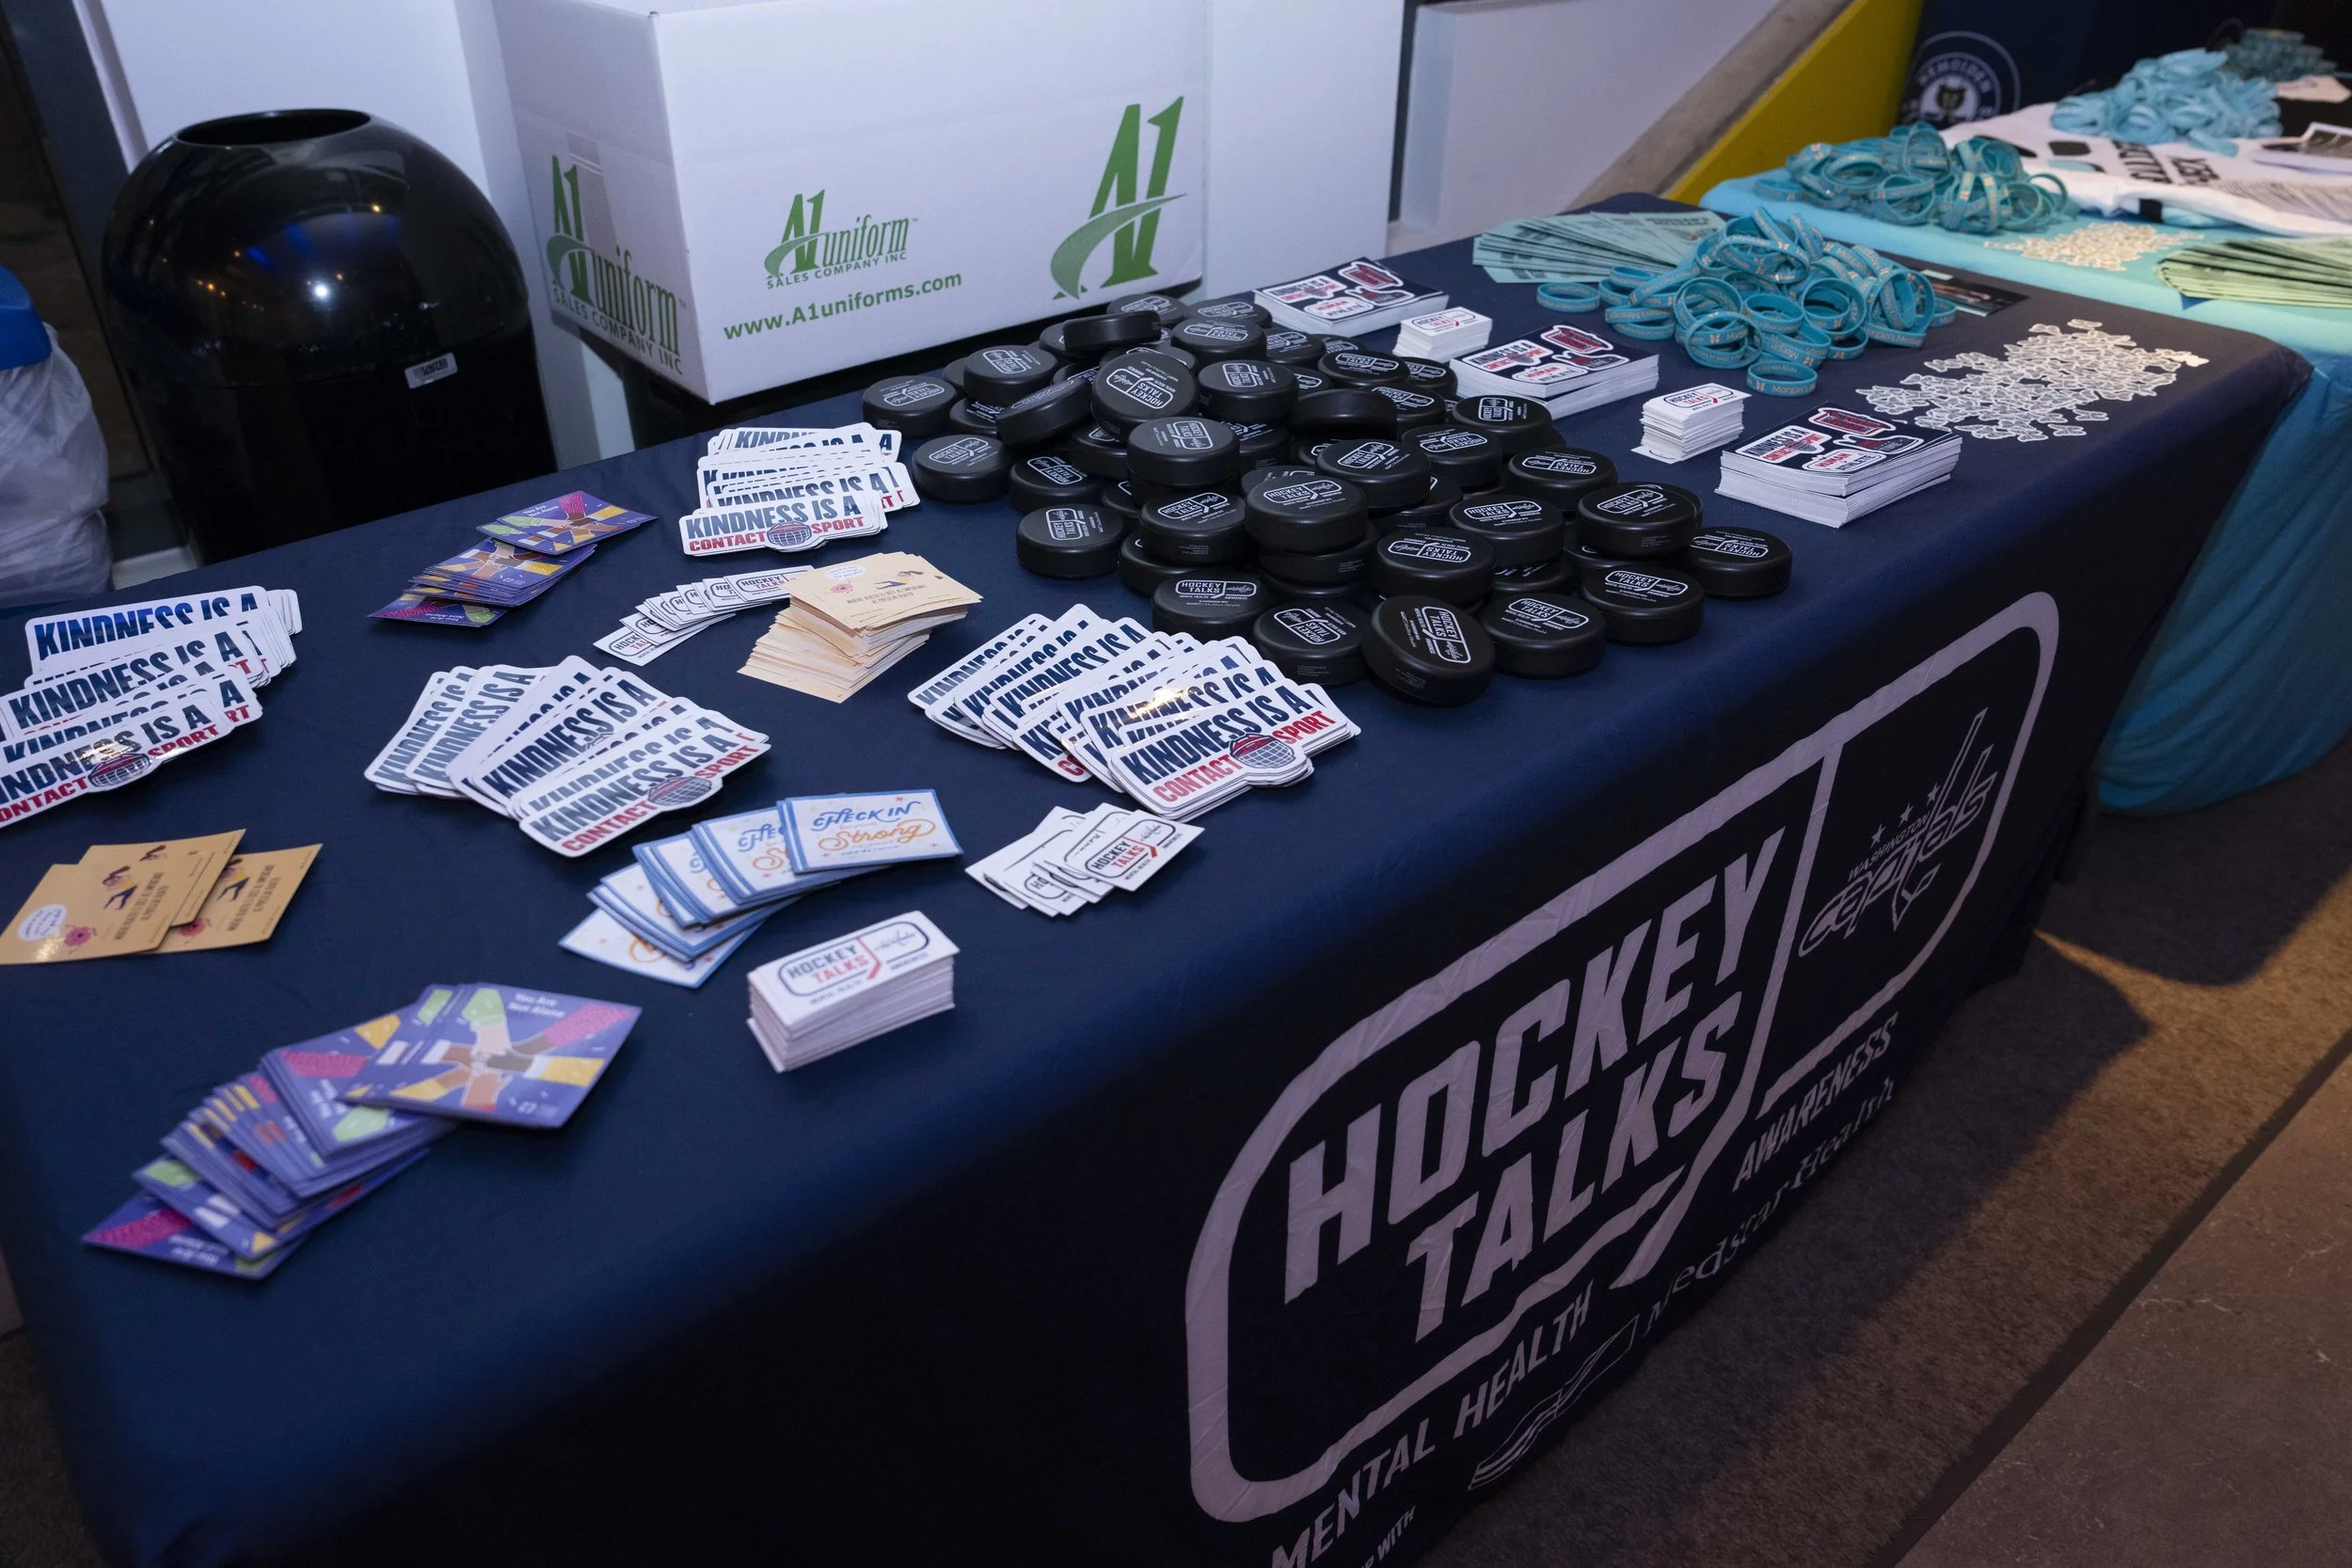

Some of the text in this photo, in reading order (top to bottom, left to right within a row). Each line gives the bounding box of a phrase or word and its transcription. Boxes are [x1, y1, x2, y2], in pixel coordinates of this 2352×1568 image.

[1049, 96, 1186, 300] A1
[822, 214, 909, 267] uniform
[767, 251, 907, 289] SALES COMPANY INC
[723, 273, 962, 340] www.A1uniforms.com
[554, 288, 683, 375] SALES COMPANY INC
[1131, 388, 1163, 406] HOCKEY
[1137, 382, 1163, 398] TALKS
[1267, 486, 1302, 498] HOCKEY
[1280, 490, 1311, 500] TALKS
[685, 495, 862, 539] KINDNESS IS A
[689, 516, 864, 552] CONTACT SPORT
[1422, 552, 1463, 562] HOCKEY
[1426, 546, 1457, 556] TALKS
[741, 576, 781, 587] HOCKEY
[1614, 572, 1655, 583] HOCKEY
[1618, 578, 1649, 588] TALKS
[1520, 600, 1559, 613] HOCKEY
[1521, 605, 1551, 618] TALKS
[1430, 615, 1447, 638] TALKS
[1438, 611, 1459, 640] HOCKEY
[8, 631, 244, 730] KINDNESS IS A
[1222, 673, 1255, 699] IS
[140, 705, 212, 745] IS A
[413, 671, 536, 784] KINDNESS IS A
[482, 679, 658, 798] KINDNESS IS A
[1120, 685, 1313, 785] KINDNESS IS A
[1152, 710, 1337, 802] CONTACT SPORT
[0, 775, 89, 824] ONTACT
[529, 734, 740, 842] KINDNESS IS A
[561, 745, 759, 852] CONTACT SPORT
[810, 800, 922, 832] CHECK IN
[818, 818, 937, 851] Strong
[1847, 814, 1931, 882] WASHINGTON
[1092, 841, 1131, 870] HOCKEY
[1111, 845, 1144, 869] TALKS
[787, 943, 857, 979] HOCKEY
[811, 955, 869, 984] TALKS
[1283, 826, 1786, 1306] HOCKEY
[1406, 991, 1742, 1343] TALKS
[1272, 1011, 1899, 1568] MENTAL HEALTH AWARENESS
[1377, 1506, 1416, 1556] WITH
